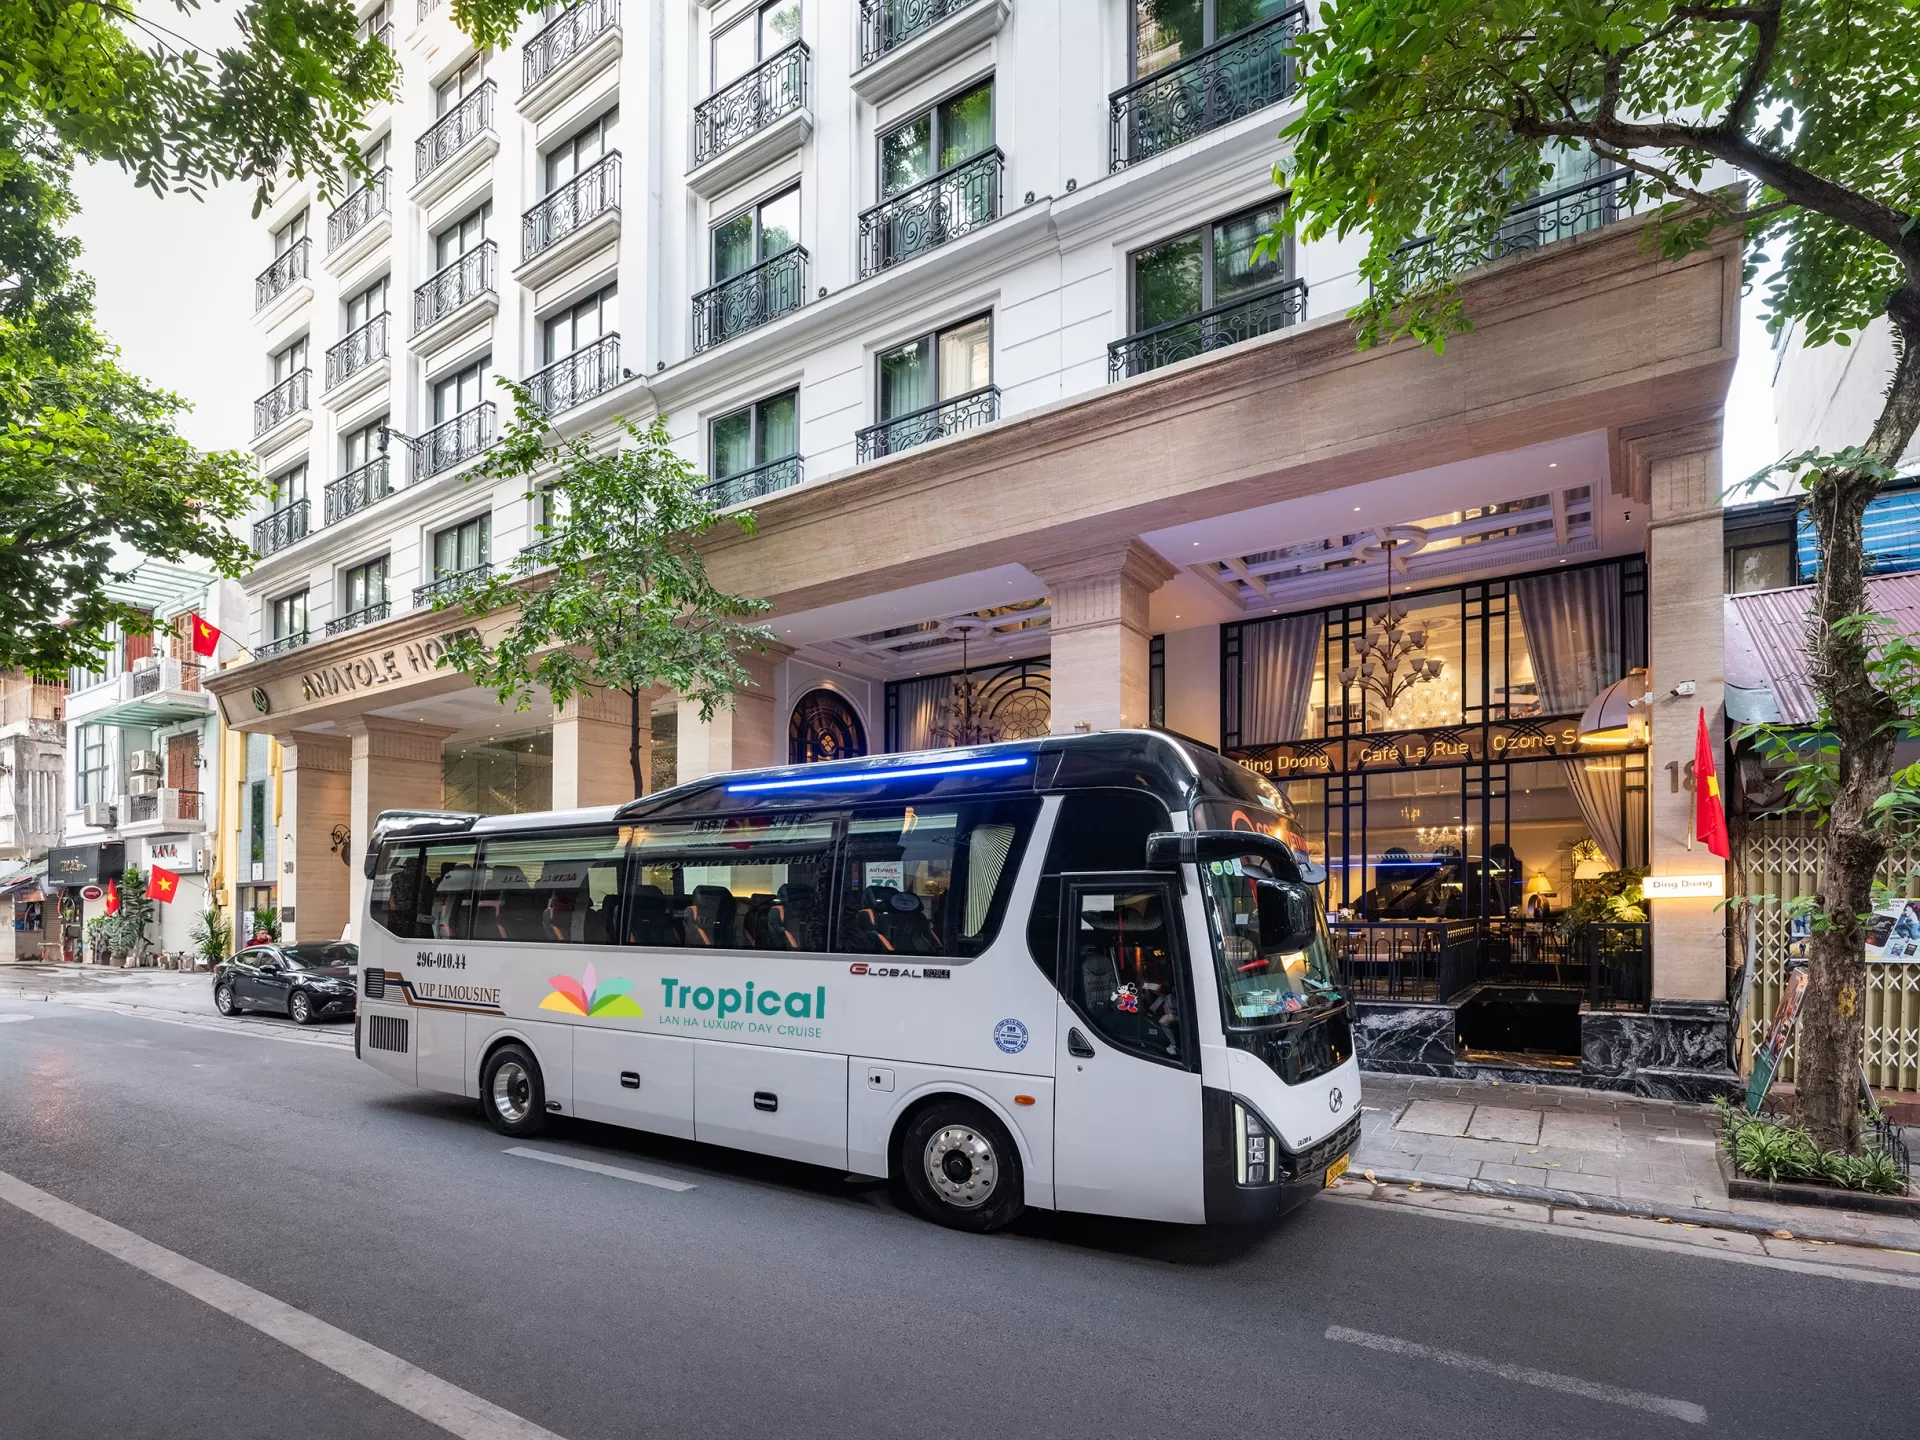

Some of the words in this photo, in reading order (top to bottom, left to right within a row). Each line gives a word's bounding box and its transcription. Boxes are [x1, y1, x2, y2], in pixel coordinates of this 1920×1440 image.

[302, 650, 402, 701] ANATOLE
[1492, 734, 1556, 751] Ozone
[1360, 745, 1399, 762] Café
[1405, 744, 1427, 759] La
[1433, 742, 1469, 756] Rue
[1278, 753, 1329, 770] Doong
[1653, 881, 1678, 890] Ding
[416, 952, 466, 969] 29G-010.44
[849, 963, 922, 978] GLOBAL
[419, 982, 436, 997] VIP
[438, 984, 501, 1003] LIMOUSINE
[661, 977, 825, 1019] Tropical
[659, 1015, 680, 1026] LAN
[683, 1017, 699, 1027] HA
[703, 1018, 744, 1030] LUXURY
[748, 1022, 773, 1034] DAY
[777, 1024, 822, 1038] CRUISE
